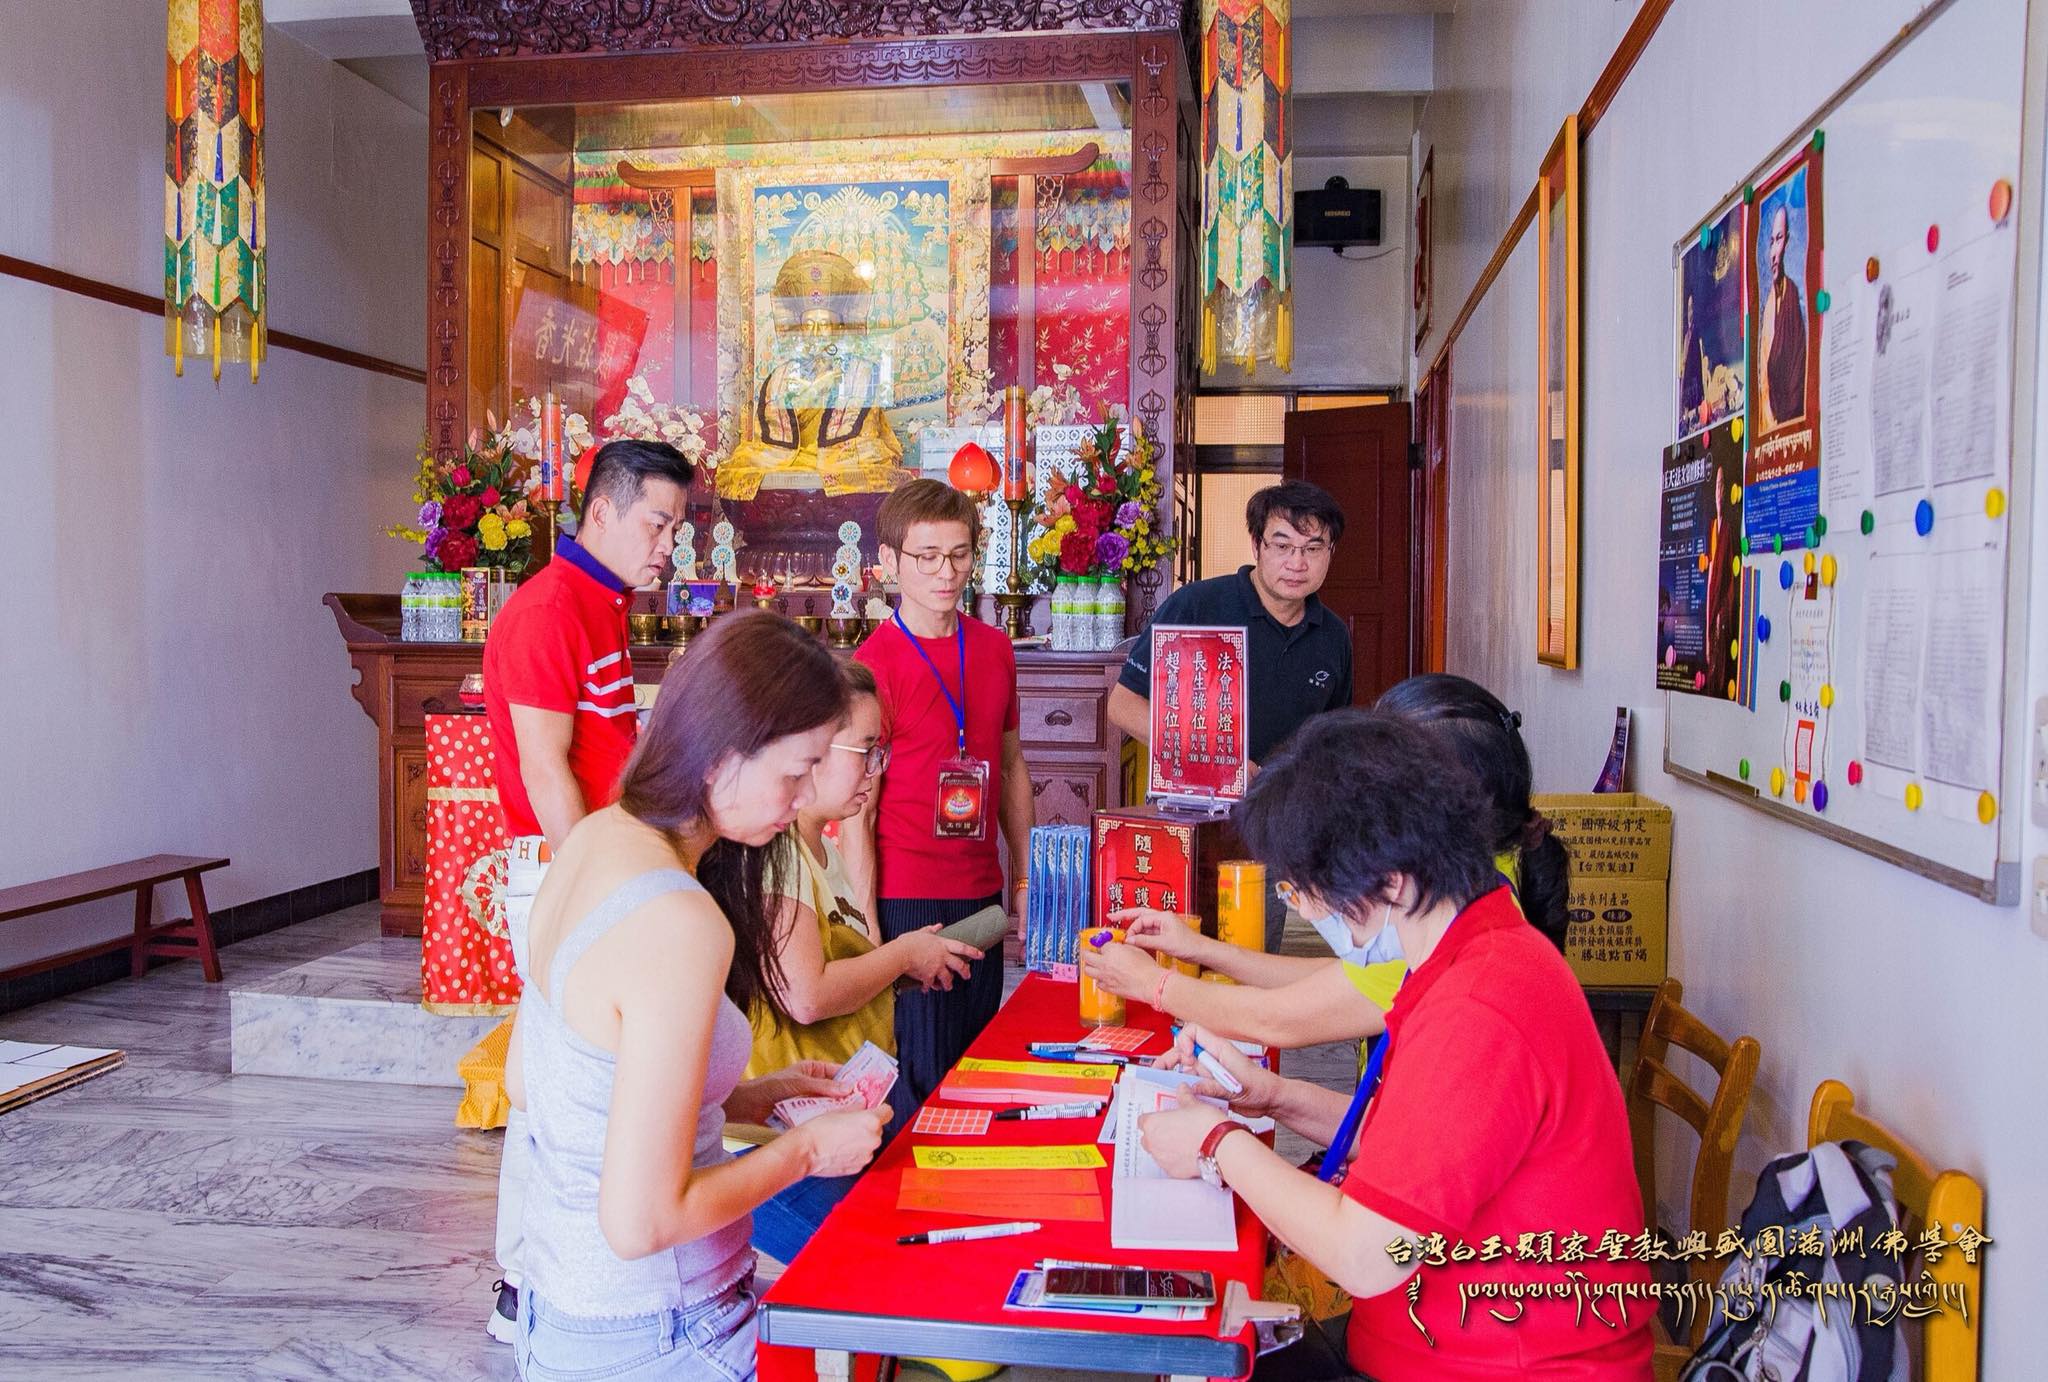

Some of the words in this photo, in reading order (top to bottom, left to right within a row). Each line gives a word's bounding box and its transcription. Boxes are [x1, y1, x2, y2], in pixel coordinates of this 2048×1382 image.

[1192, 650, 1208, 730] 長生祿位
[1217, 651, 1234, 732] 法會供燈
[1135, 834, 1152, 874] 隨喜
